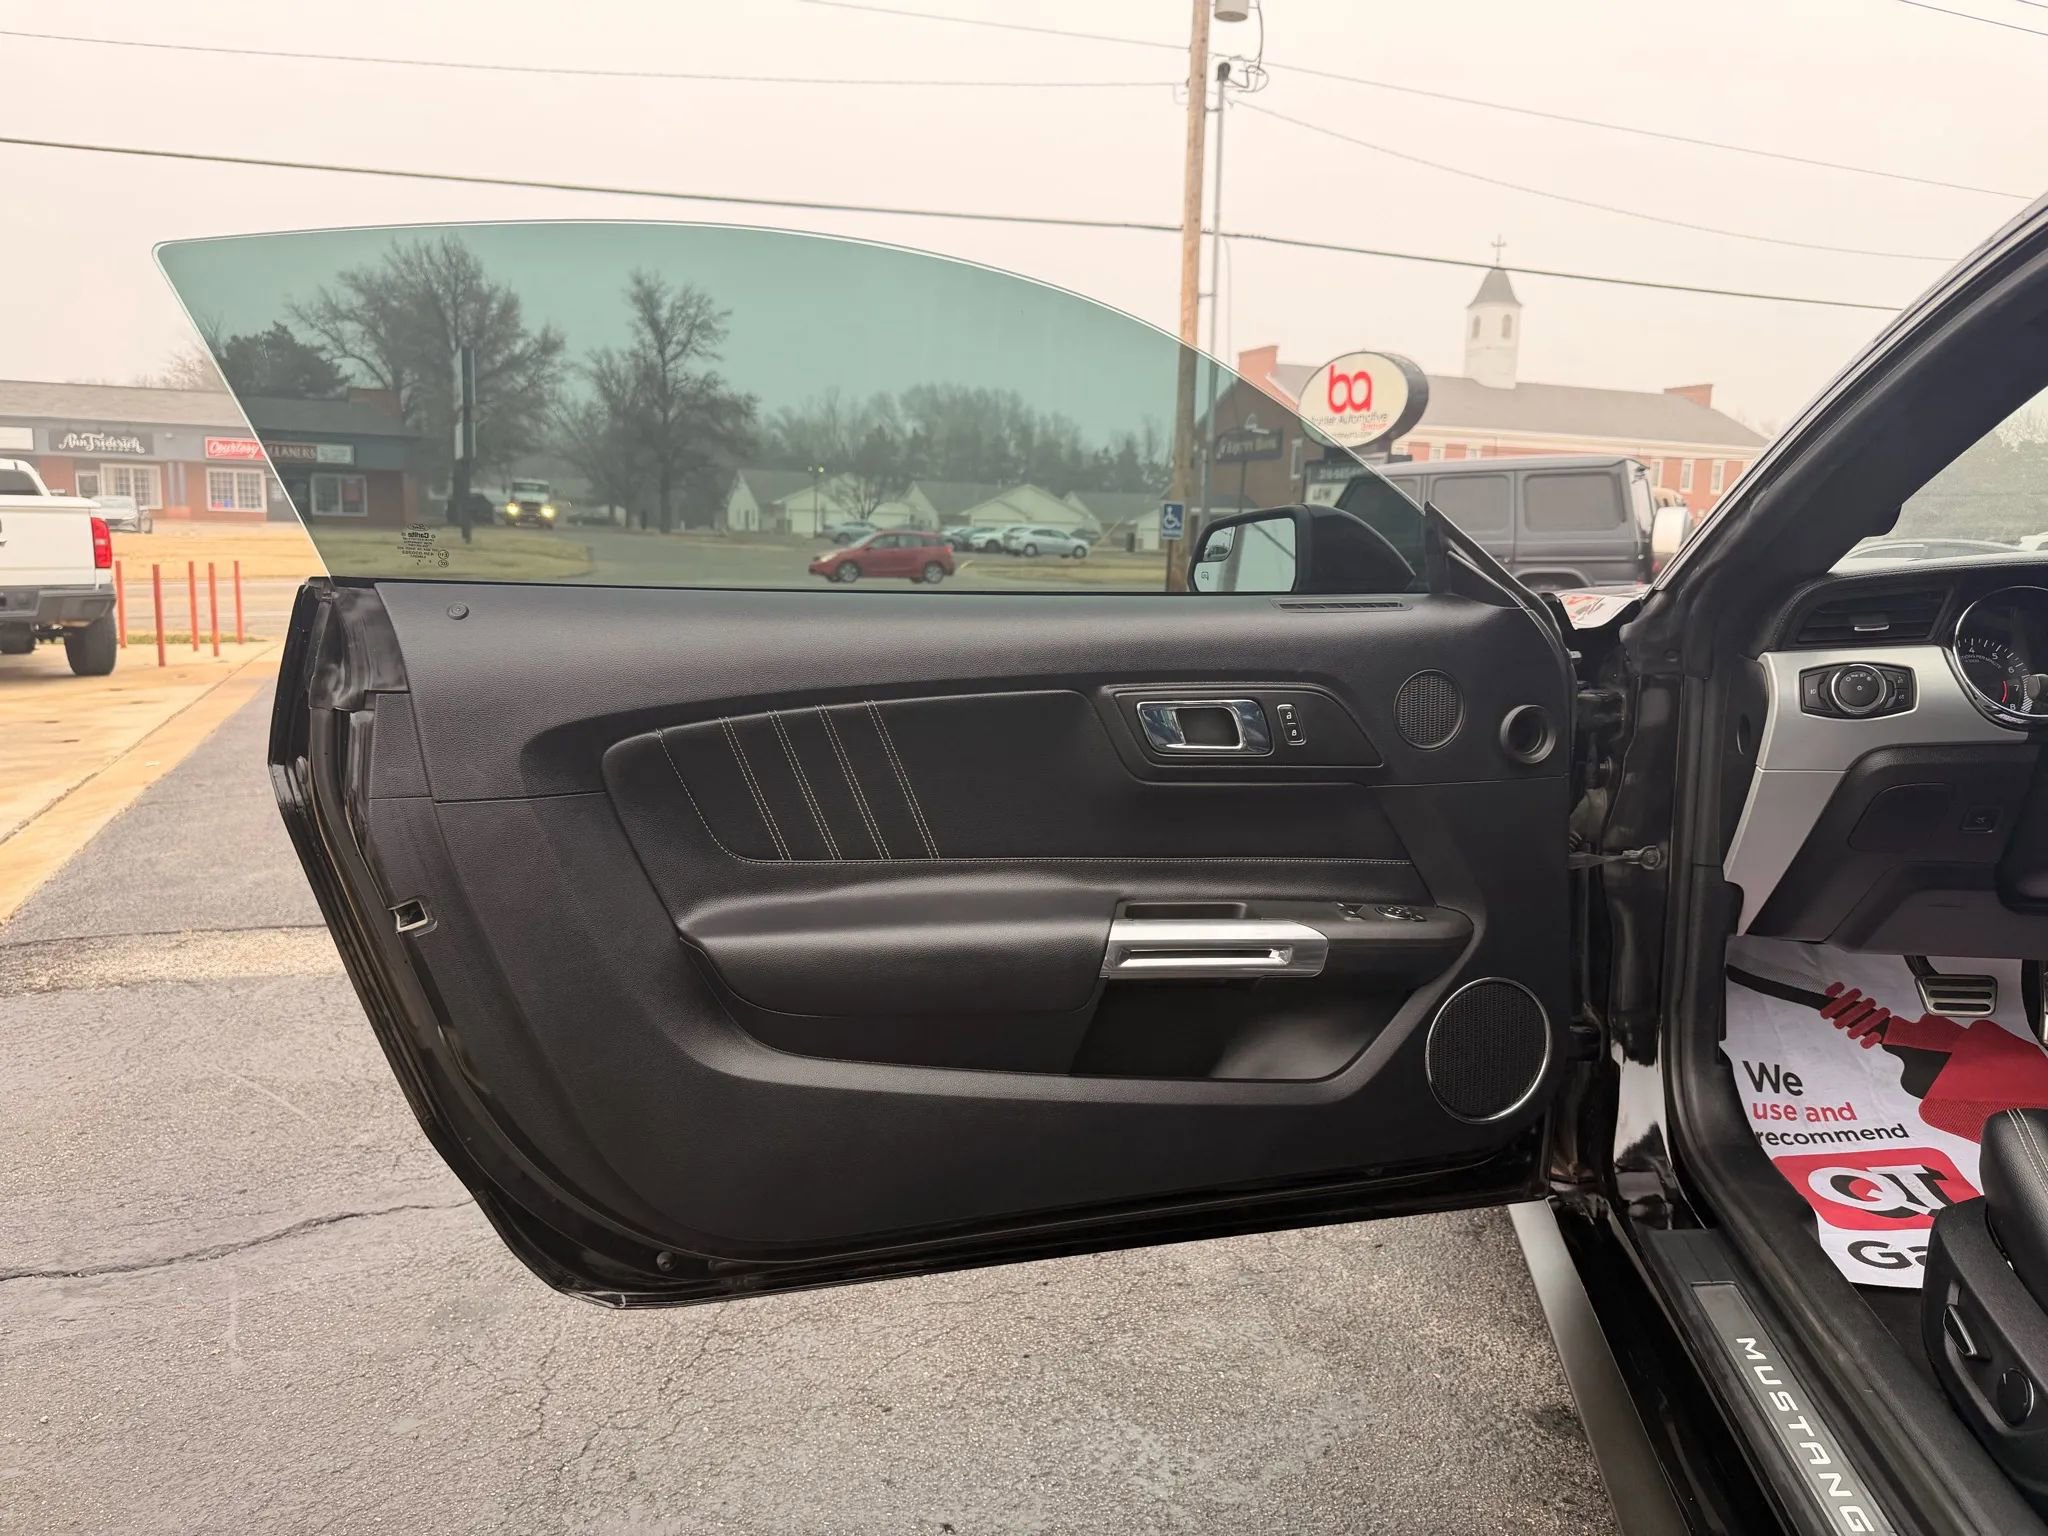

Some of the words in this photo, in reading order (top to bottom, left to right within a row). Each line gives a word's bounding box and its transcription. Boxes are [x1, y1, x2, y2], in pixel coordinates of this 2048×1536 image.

[1328, 364, 1372, 413] ba
[2014, 684, 2020, 692] 7
[1742, 1060, 1803, 1096] We
[1752, 1102, 1798, 1122] use
[1805, 1101, 1858, 1123] and
[1756, 1123, 1910, 1146] recommend
[1807, 1164, 1948, 1218] QT
[1735, 1337, 1876, 1533] MUSTANG
